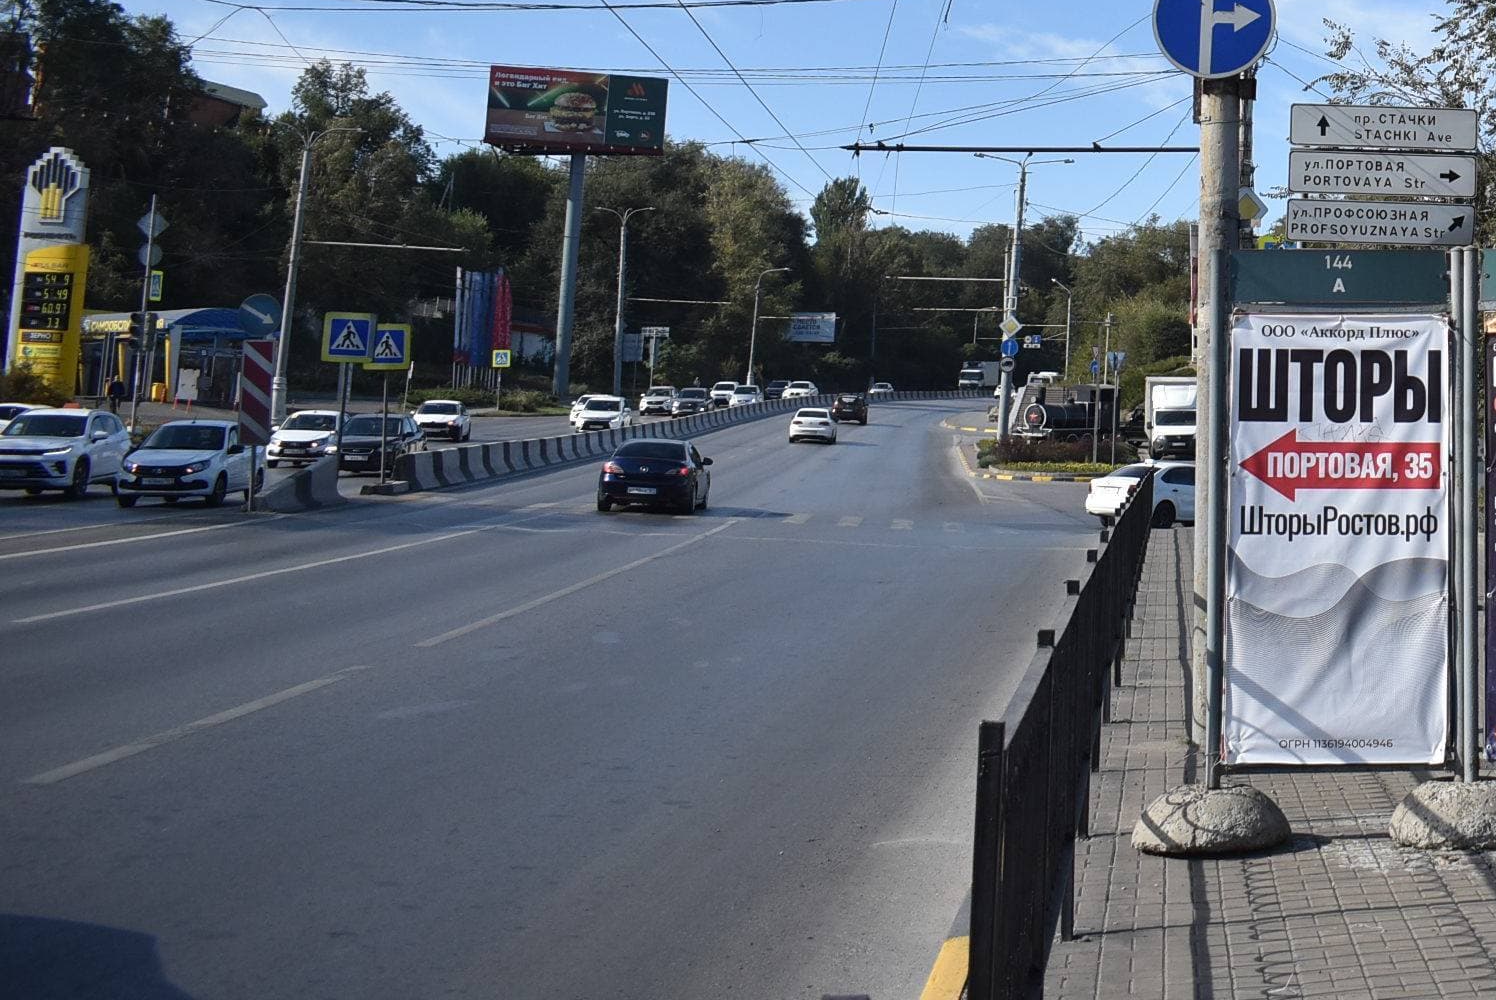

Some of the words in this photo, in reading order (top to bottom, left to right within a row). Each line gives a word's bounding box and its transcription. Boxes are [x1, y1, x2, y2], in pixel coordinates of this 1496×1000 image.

[1379, 113, 1437, 126] СТАЧКИ
[1354, 129, 1417, 141] STACHKI
[1427, 132, 1452, 142] Ave
[1303, 175, 1392, 187] PORTOVAYA
[1404, 177, 1426, 189] Str
[1291, 223, 1419, 236] PROFSOYUZNAYA
[1424, 227, 1445, 238] Str
[1324, 254, 1353, 269] 144
[1261, 324, 1296, 338] ООО
[1301, 325, 1365, 341] «Аккорд
[1369, 326, 1419, 339] Плюс»
[1239, 348, 1441, 423] ШТОРЫ
[1267, 452, 1398, 482] ПОРТОВАЯ,
[1405, 452, 1432, 478] 35
[1240, 505, 1438, 542] ШторыРостов.рф
[1280, 739, 1310, 748] ОГРН
[1314, 739, 1393, 748] 1136194004946
